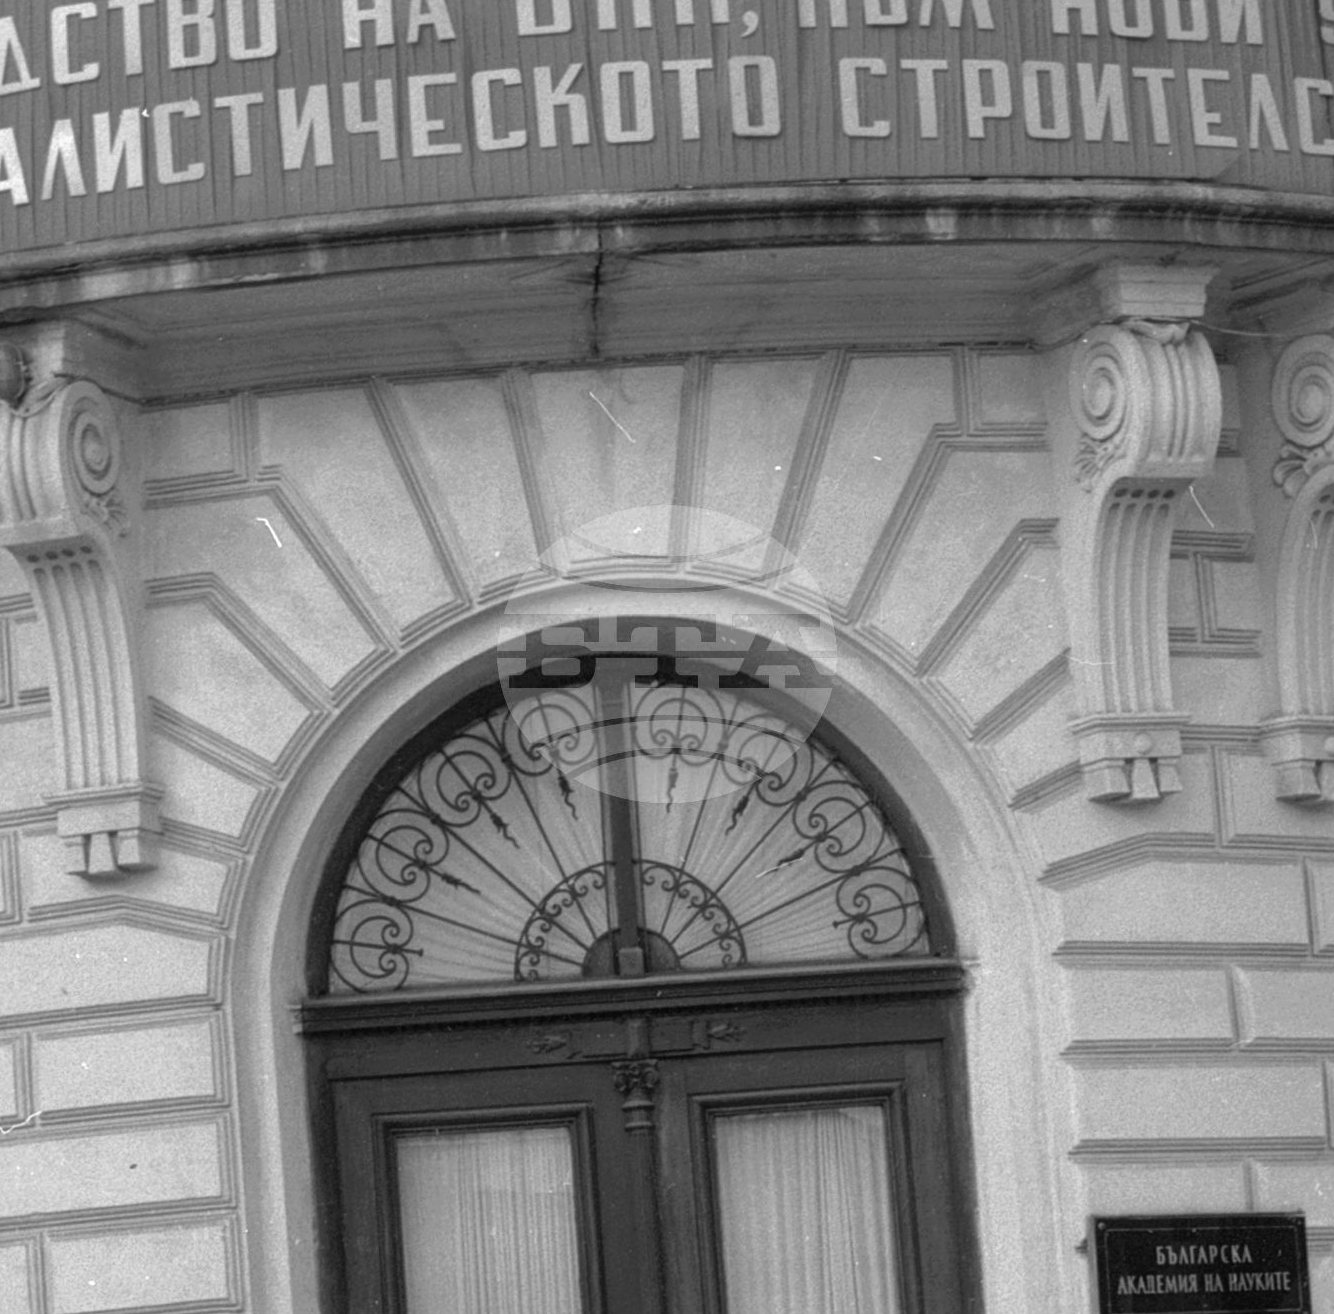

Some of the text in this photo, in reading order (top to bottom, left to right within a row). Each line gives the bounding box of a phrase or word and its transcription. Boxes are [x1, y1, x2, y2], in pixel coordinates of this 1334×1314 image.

[1155, 1244, 1253, 1266] БЪЛГАРСКА
[1117, 1271, 1292, 1296] АКАДЕМИЯ НА НАУКИТЕ
